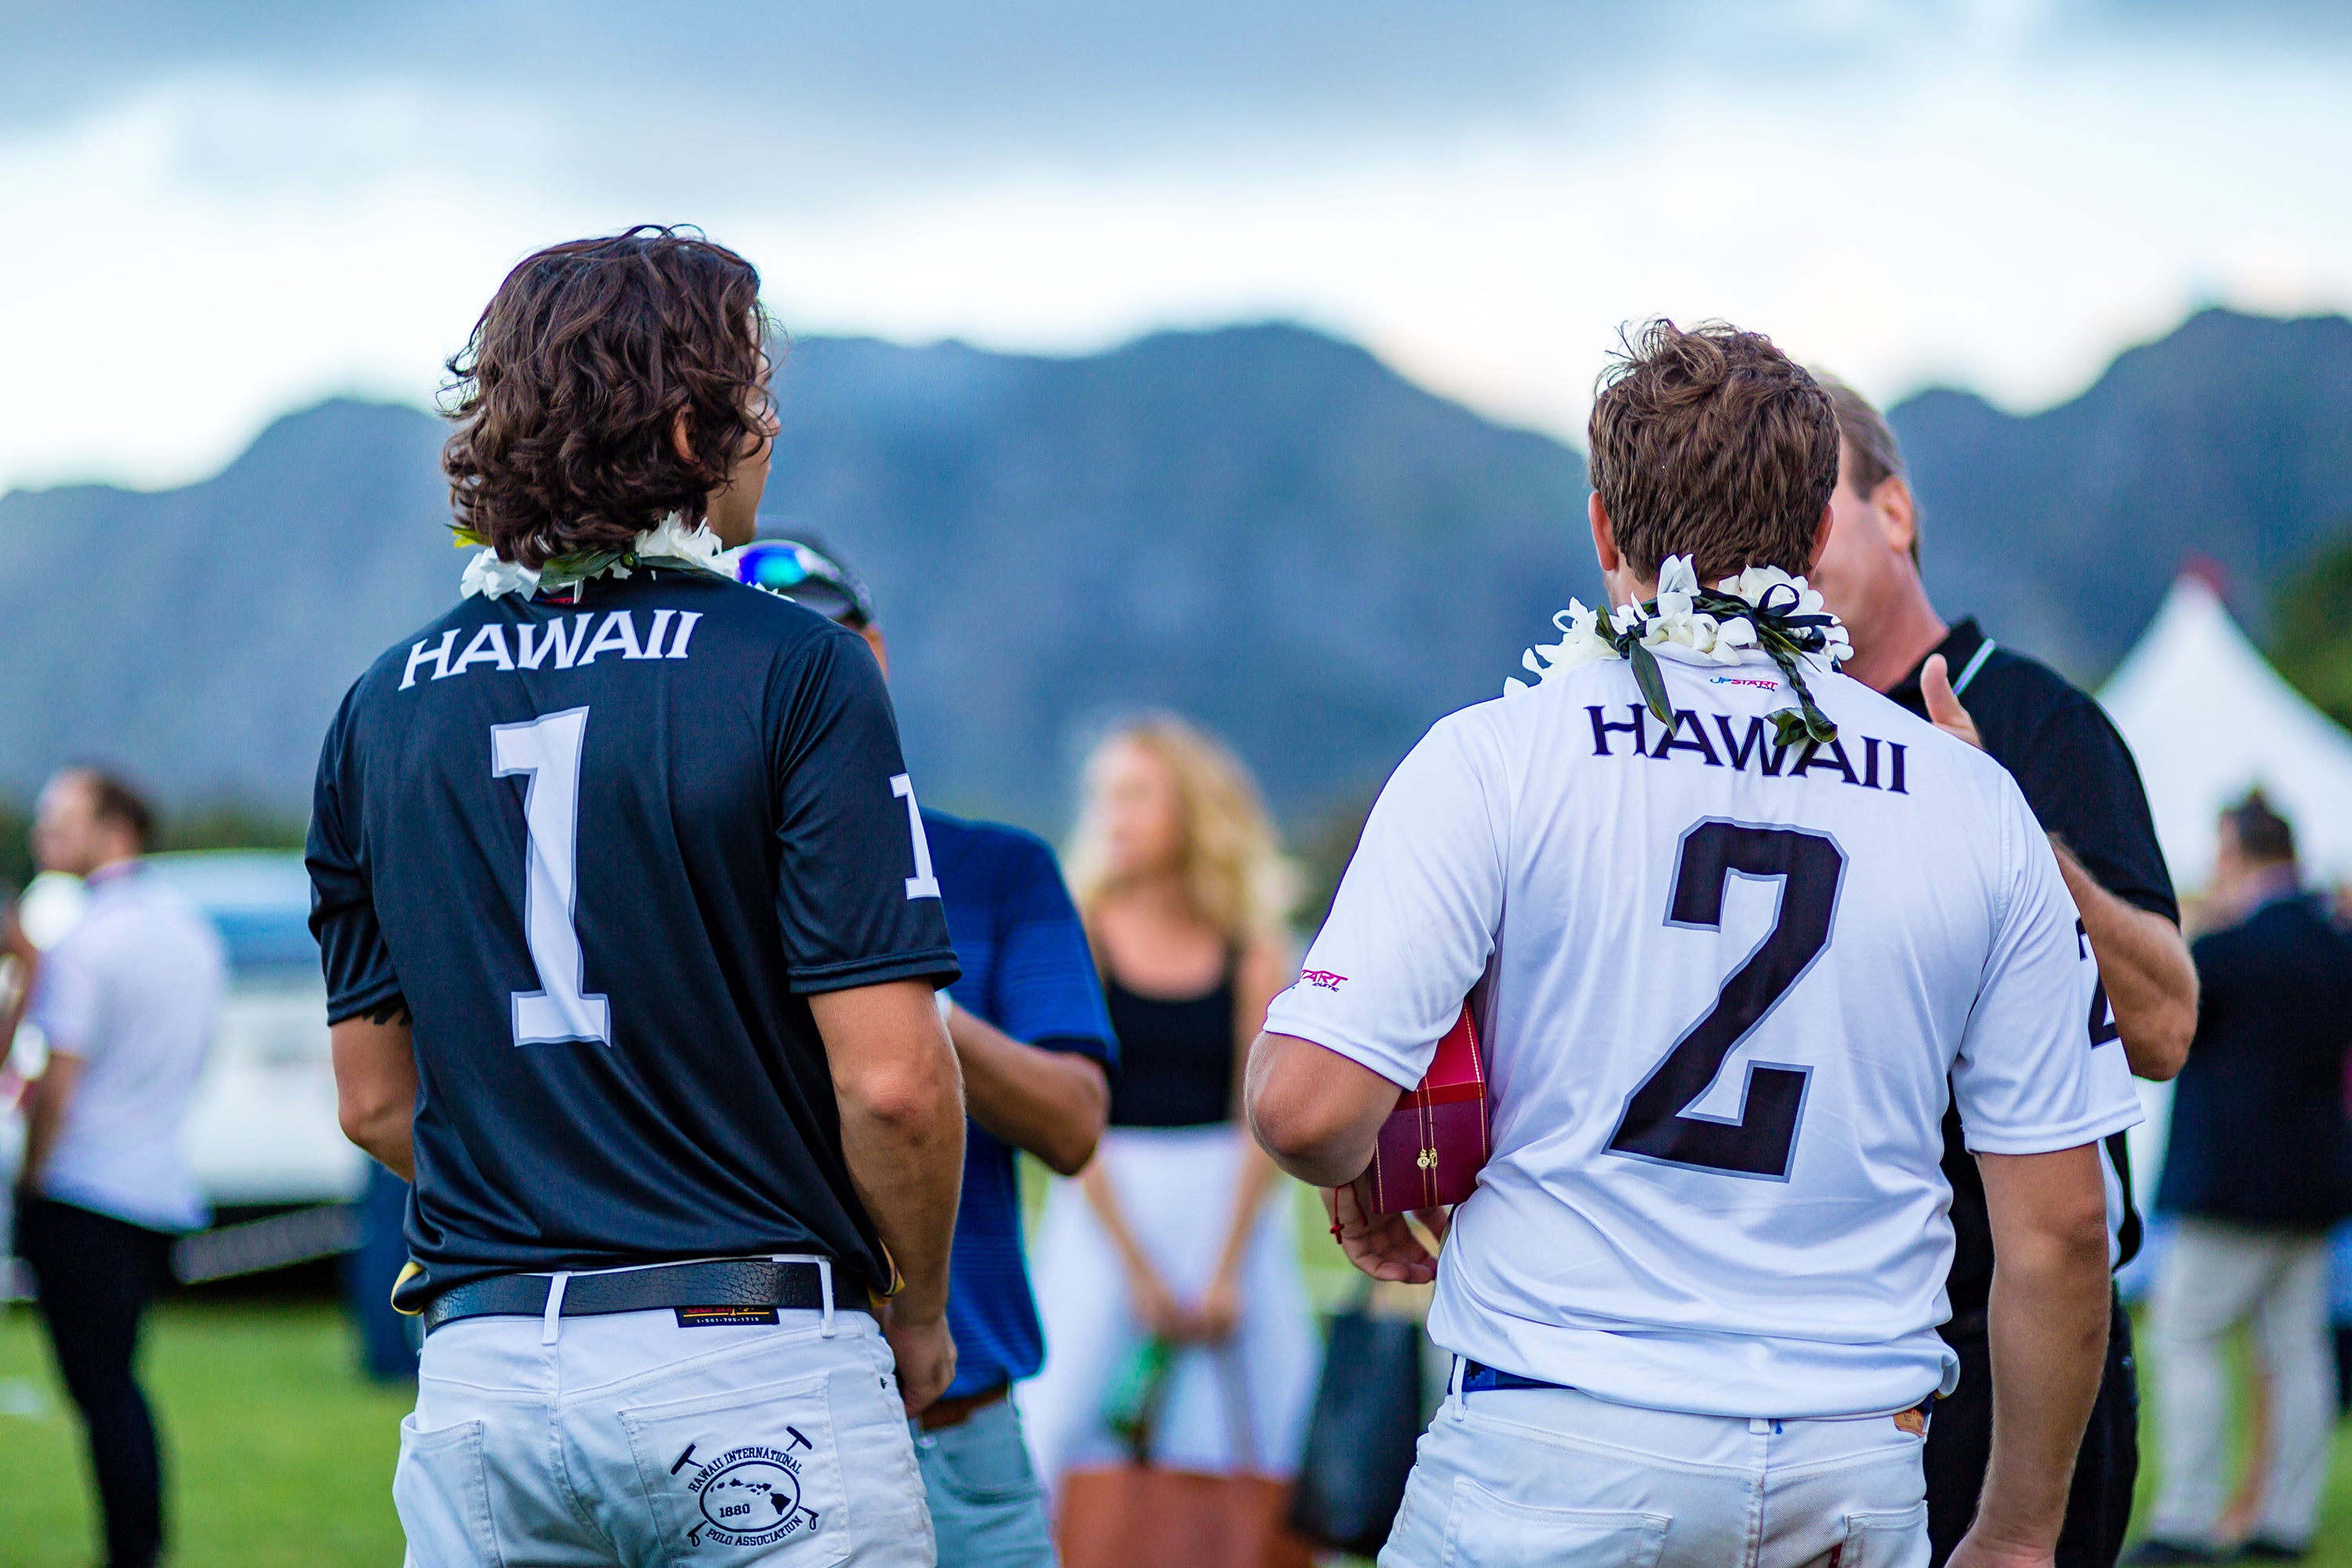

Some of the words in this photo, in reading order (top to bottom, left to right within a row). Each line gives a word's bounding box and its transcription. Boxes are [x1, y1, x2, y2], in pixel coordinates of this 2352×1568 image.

[398, 609, 703, 691] HAWAII
[1583, 703, 1910, 795] HAWAII
[491, 706, 611, 1047] 1
[890, 773, 941, 899] 1
[1600, 815, 1849, 1184] 2
[688, 1458, 724, 1493] HAWAII
[724, 1447, 802, 1474] INTERNATIONAL
[720, 1504, 750, 1518] 1880
[706, 1528, 733, 1545] POLO
[735, 1515, 803, 1546] ASSOCIATION
